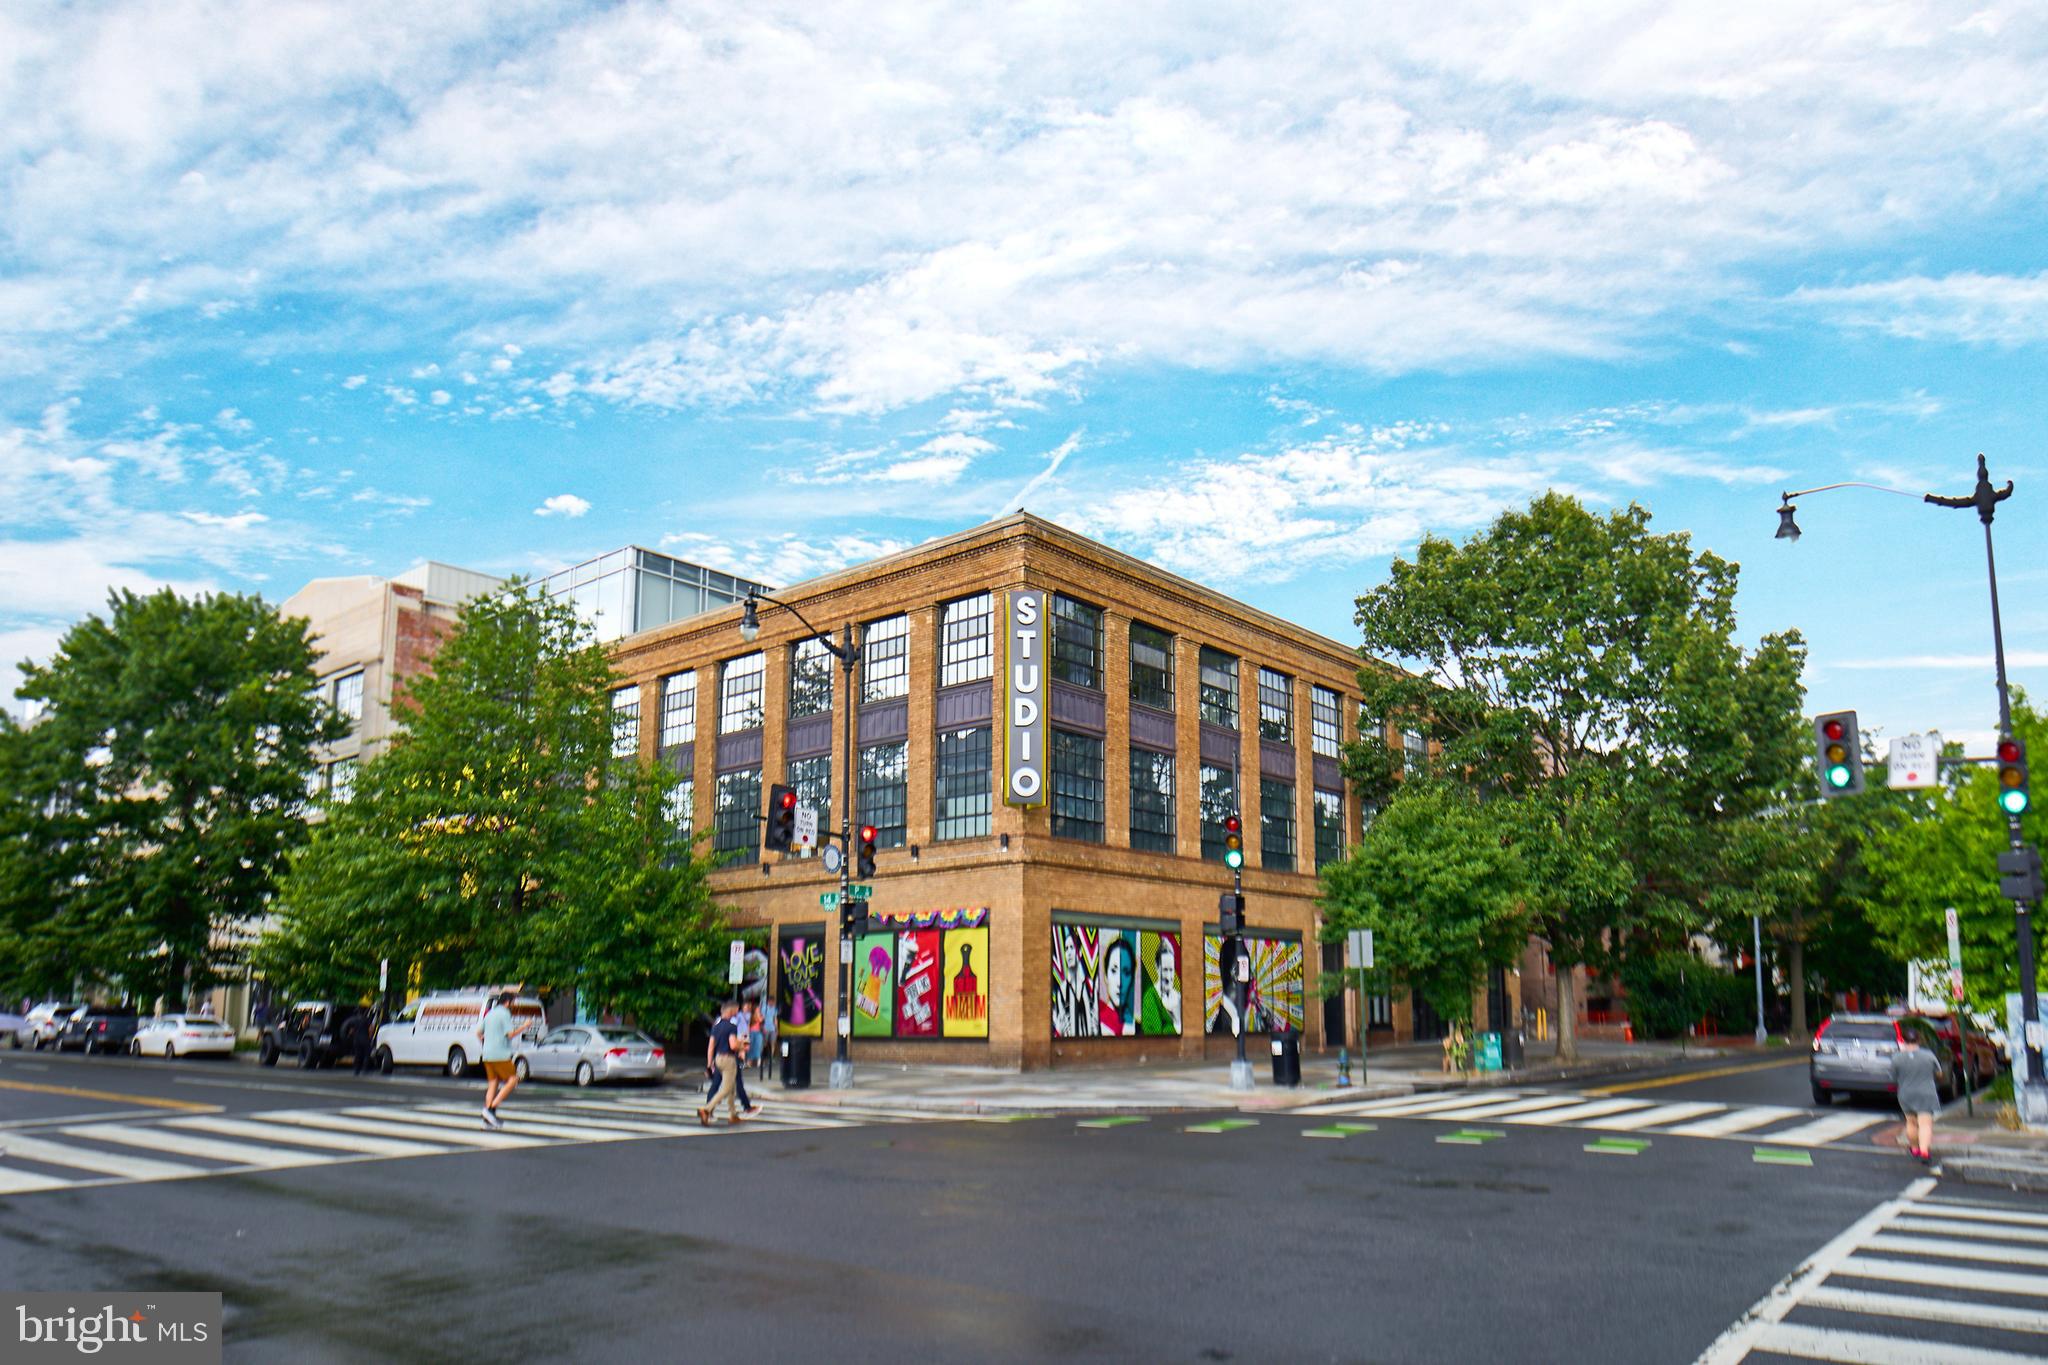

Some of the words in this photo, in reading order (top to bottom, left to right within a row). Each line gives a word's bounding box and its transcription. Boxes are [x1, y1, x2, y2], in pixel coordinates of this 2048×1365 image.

[1011, 596, 1041, 797] STUDIO
[801, 811, 812, 820] NO
[796, 825, 804, 833] ON
